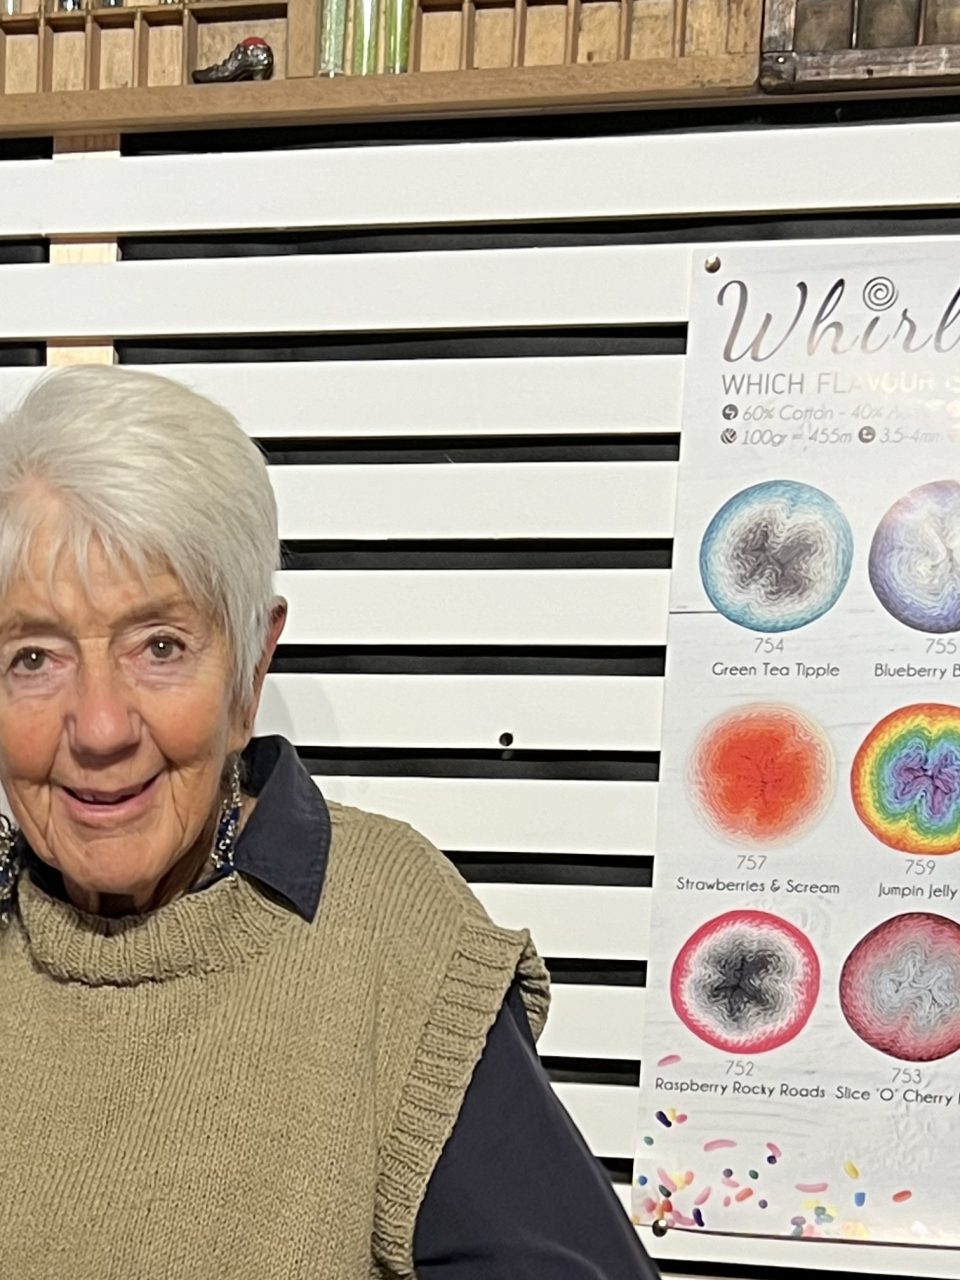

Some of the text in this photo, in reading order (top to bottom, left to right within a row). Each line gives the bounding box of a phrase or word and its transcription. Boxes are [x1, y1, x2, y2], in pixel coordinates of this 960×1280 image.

[722, 373, 804, 395] WHICH
[742, 405, 775, 420] 60%
[742, 429, 788, 447] 100gr
[754, 637, 784, 653] 754
[925, 638, 957, 654] 755
[712, 662, 840, 679] Green Tea Tipple
[874, 662, 947, 680] Blueberry
[736, 854, 767, 870] 757
[905, 859, 936, 875] 759
[676, 876, 840, 894] Strawberries & Scream
[877, 882, 958, 900] Jumpin Jelly
[725, 1060, 755, 1077] 752
[891, 1067, 923, 1084] 753
[655, 1077, 826, 1098] Raspberry Rocky Roads
[835, 1085, 871, 1101] Slice
[903, 1088, 953, 1107] Cherry
